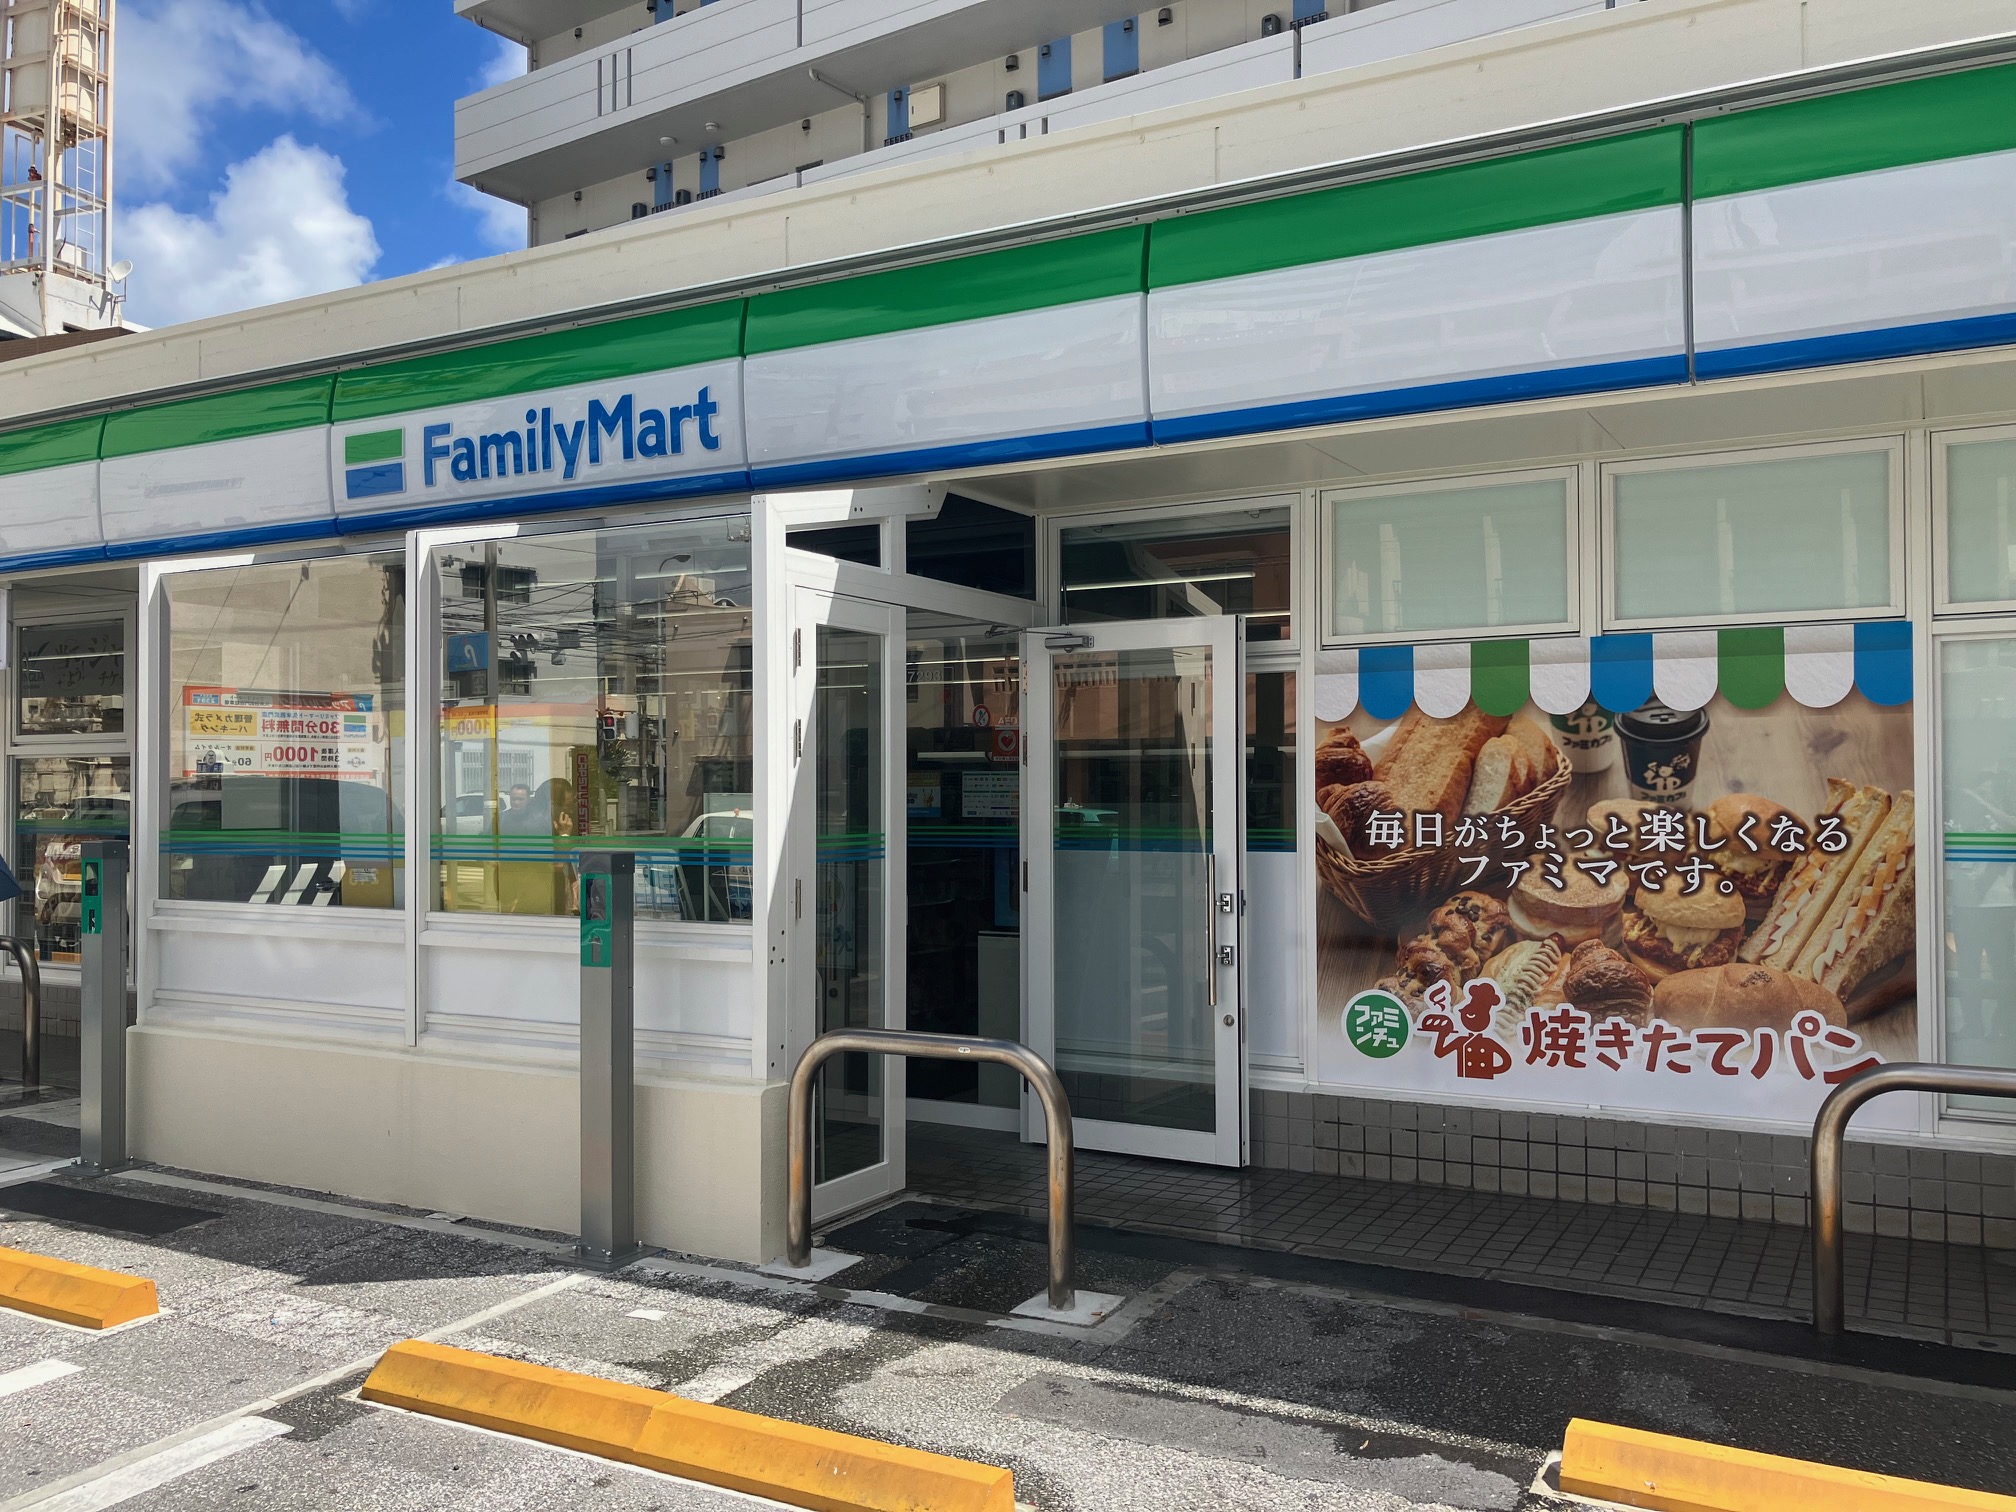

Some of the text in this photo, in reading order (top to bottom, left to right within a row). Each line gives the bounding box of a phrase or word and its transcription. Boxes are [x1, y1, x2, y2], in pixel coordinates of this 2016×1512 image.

[423, 385, 719, 487] FamilyMart
[1364, 808, 1849, 852] 毎日がちょっと楽しくなる
[1457, 854, 1735, 896] ファミマです。
[1353, 1003, 1400, 1028] ファミ
[1356, 1025, 1400, 1050] ンチュ
[1523, 1008, 1884, 1085] 焼きたてパン
